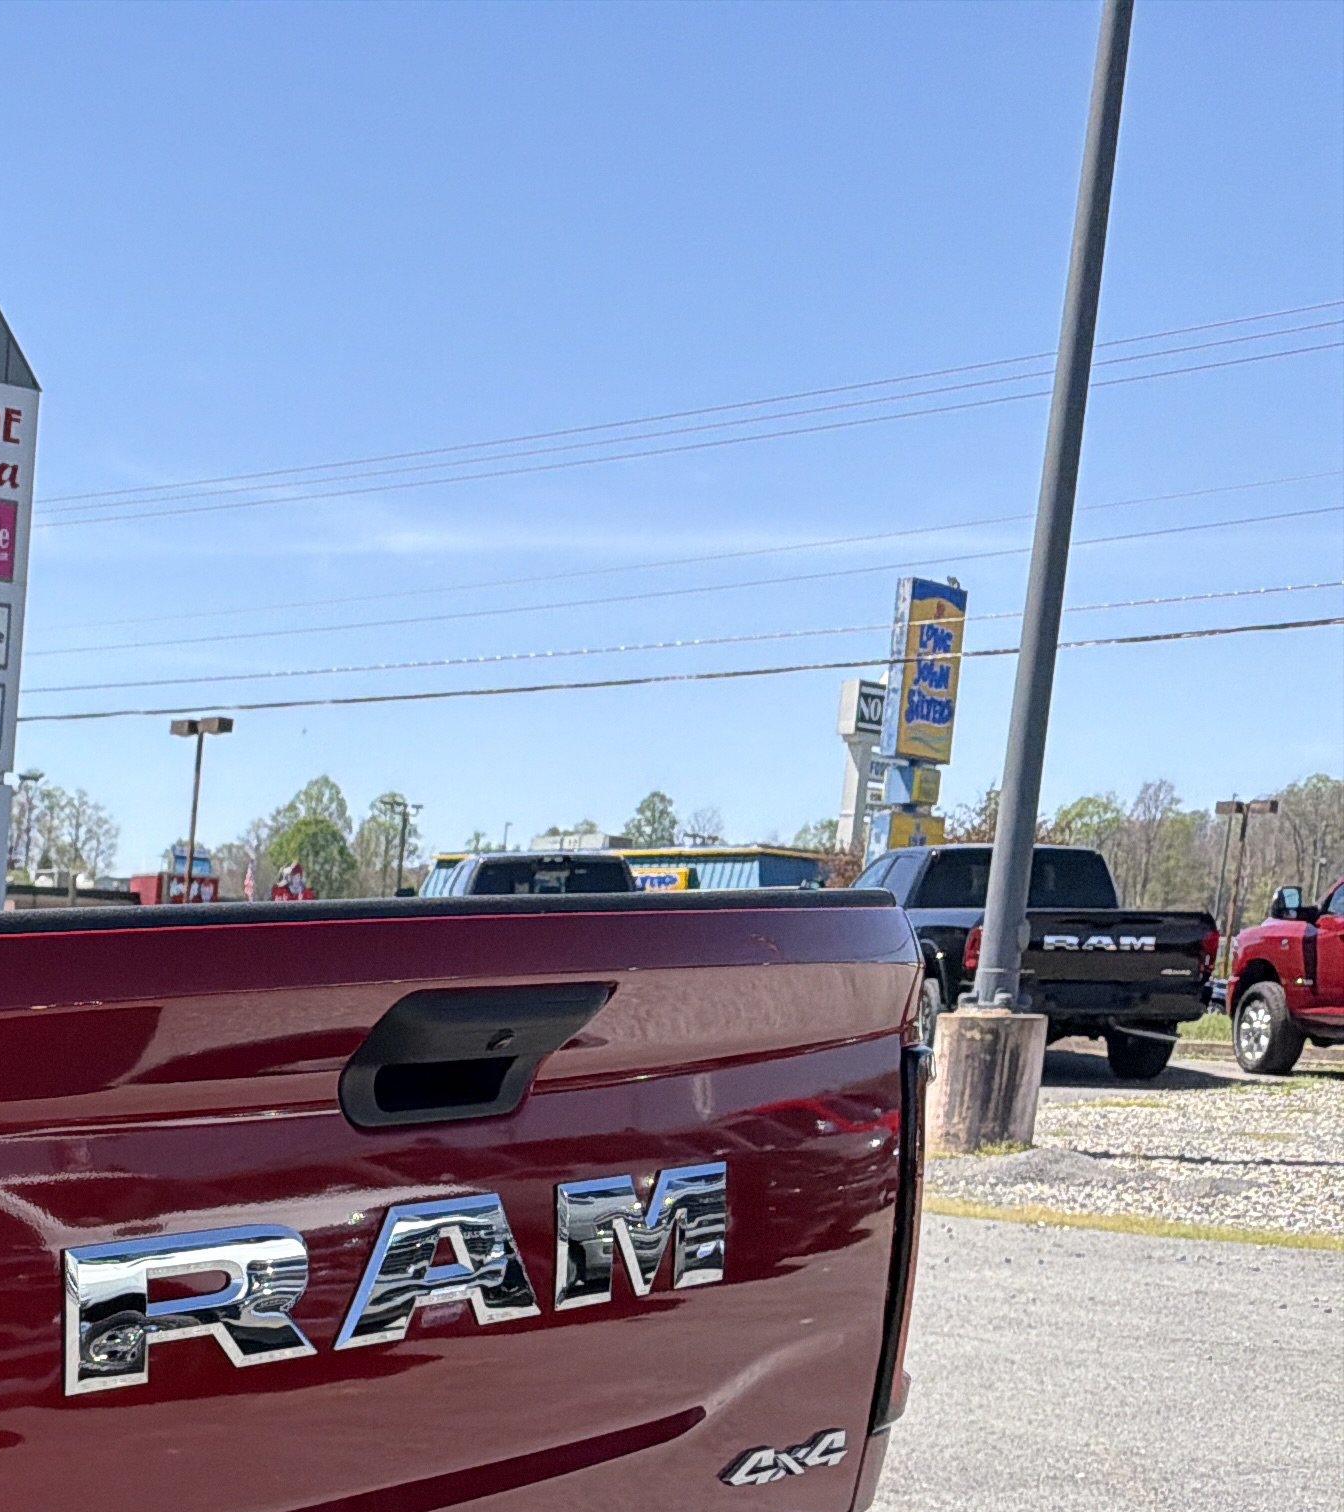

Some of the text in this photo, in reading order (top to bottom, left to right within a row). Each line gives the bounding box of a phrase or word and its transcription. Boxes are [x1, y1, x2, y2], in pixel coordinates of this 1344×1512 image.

[918, 623, 954, 653] LONG
[913, 656, 952, 690] JOHN
[1043, 934, 1157, 951] RAM
[64, 1161, 727, 1396] RAM
[718, 1427, 848, 1487] 4x4
